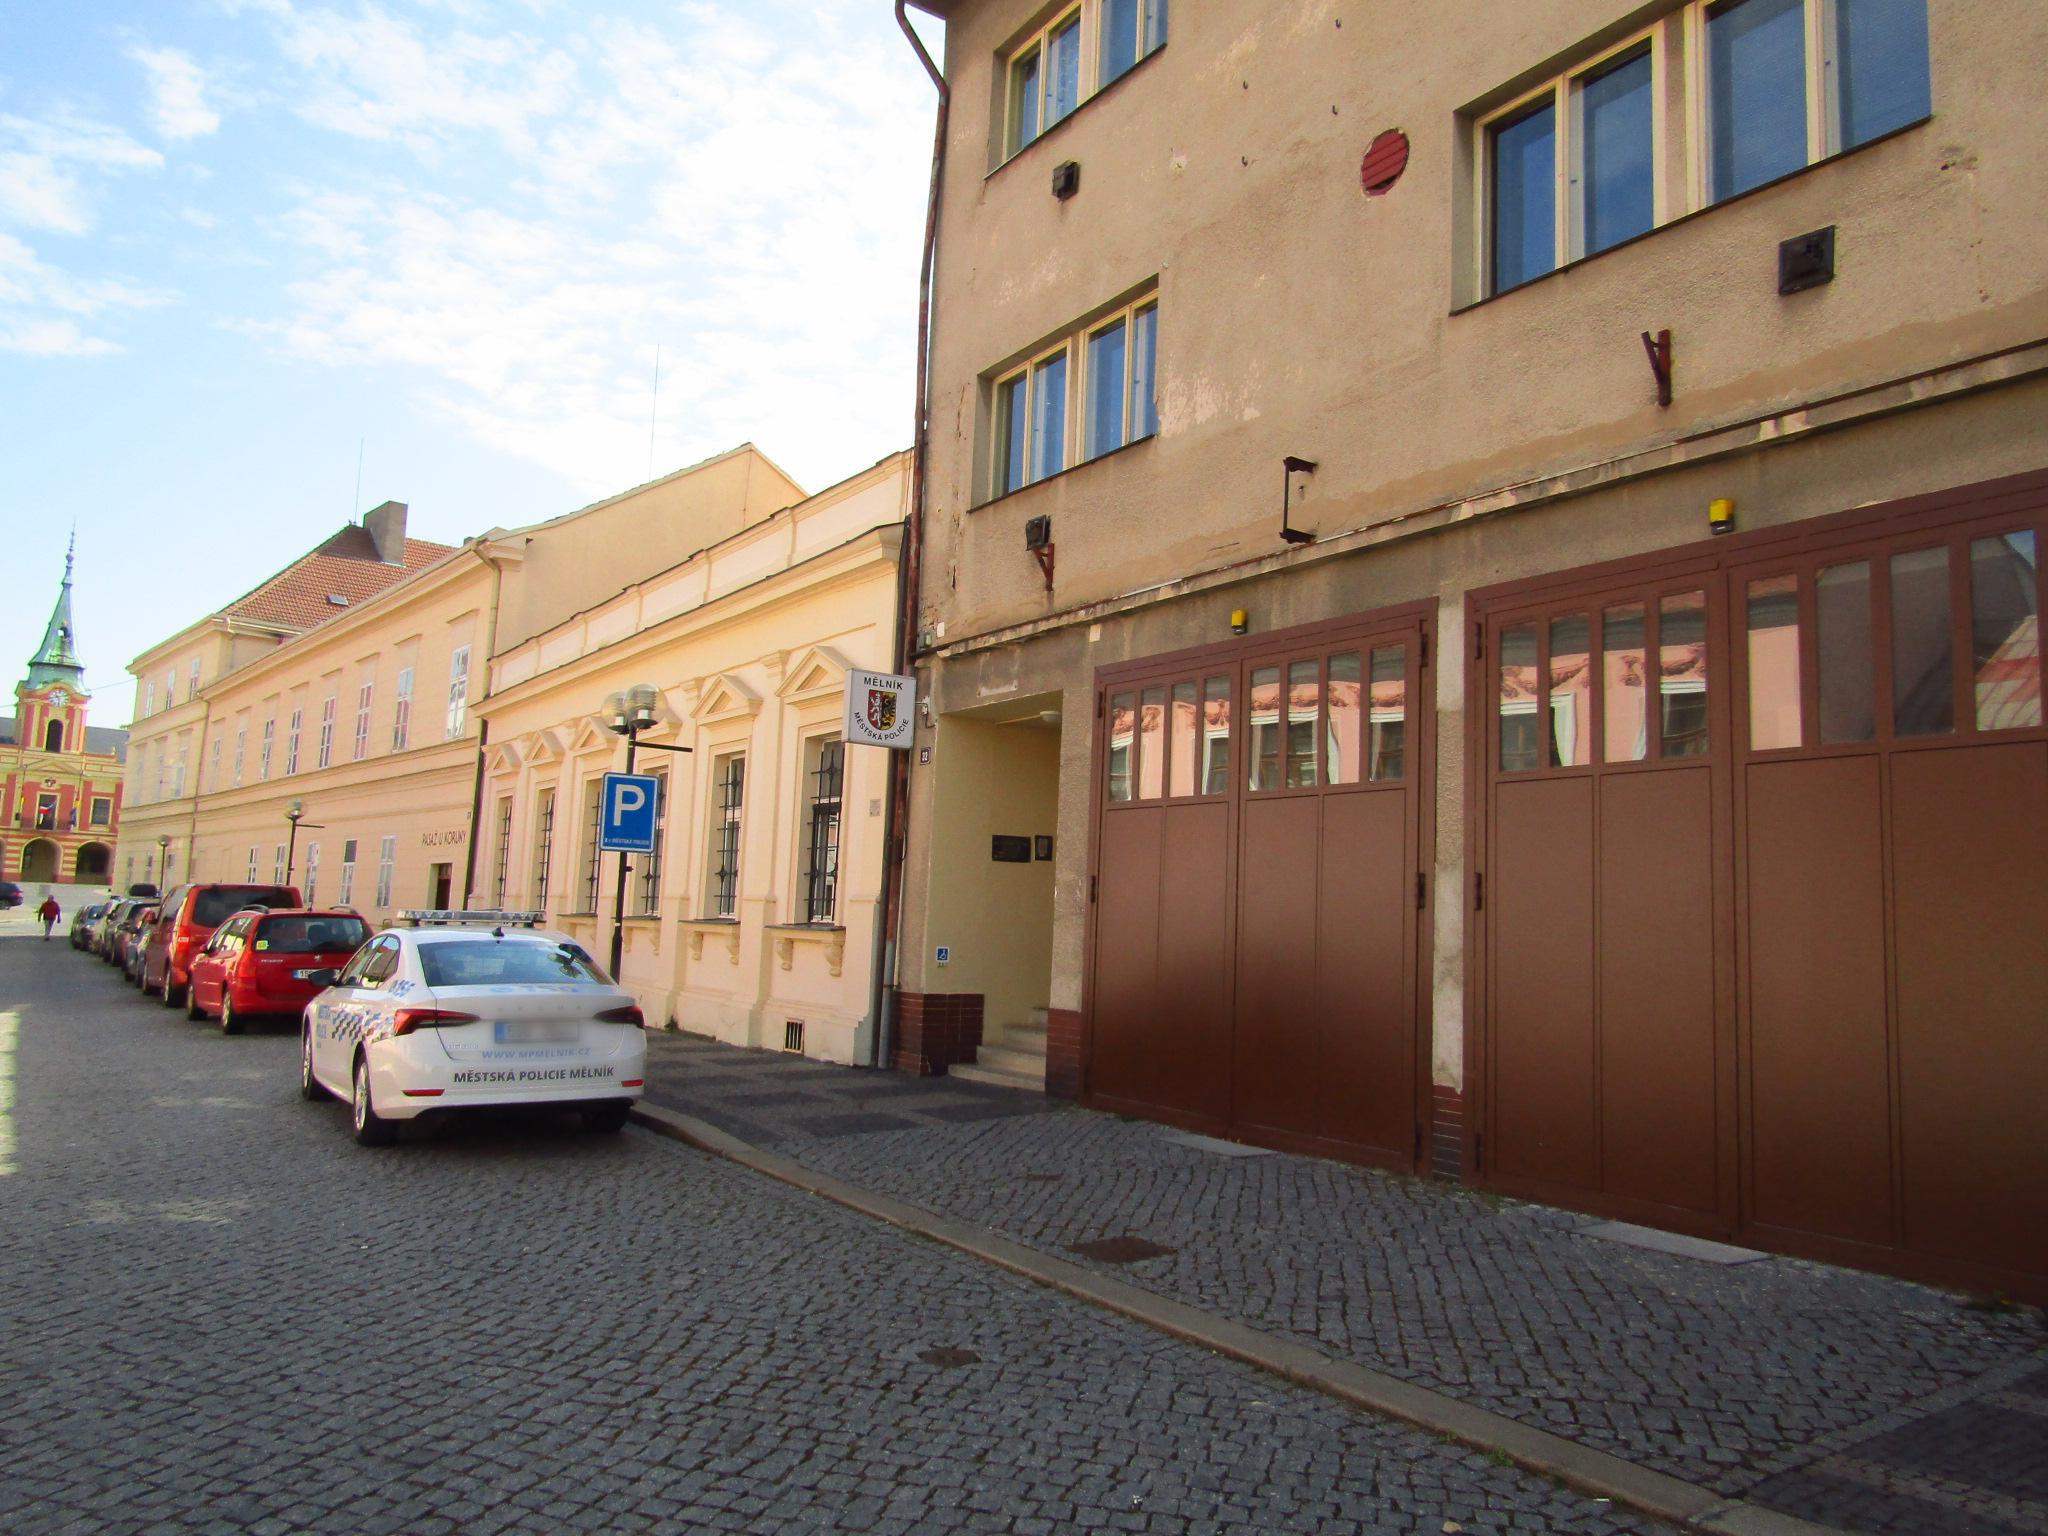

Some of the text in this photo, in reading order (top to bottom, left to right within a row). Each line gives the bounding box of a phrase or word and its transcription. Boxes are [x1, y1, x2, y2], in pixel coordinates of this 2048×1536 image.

[863, 676, 903, 690] MĚLNÍK
[854, 712, 909, 741] MĚSTSKÁ POLICIE
[613, 784, 645, 826] P
[454, 1065, 614, 1083] MĚSTSKÁ POLICIE MĚLNÍK
